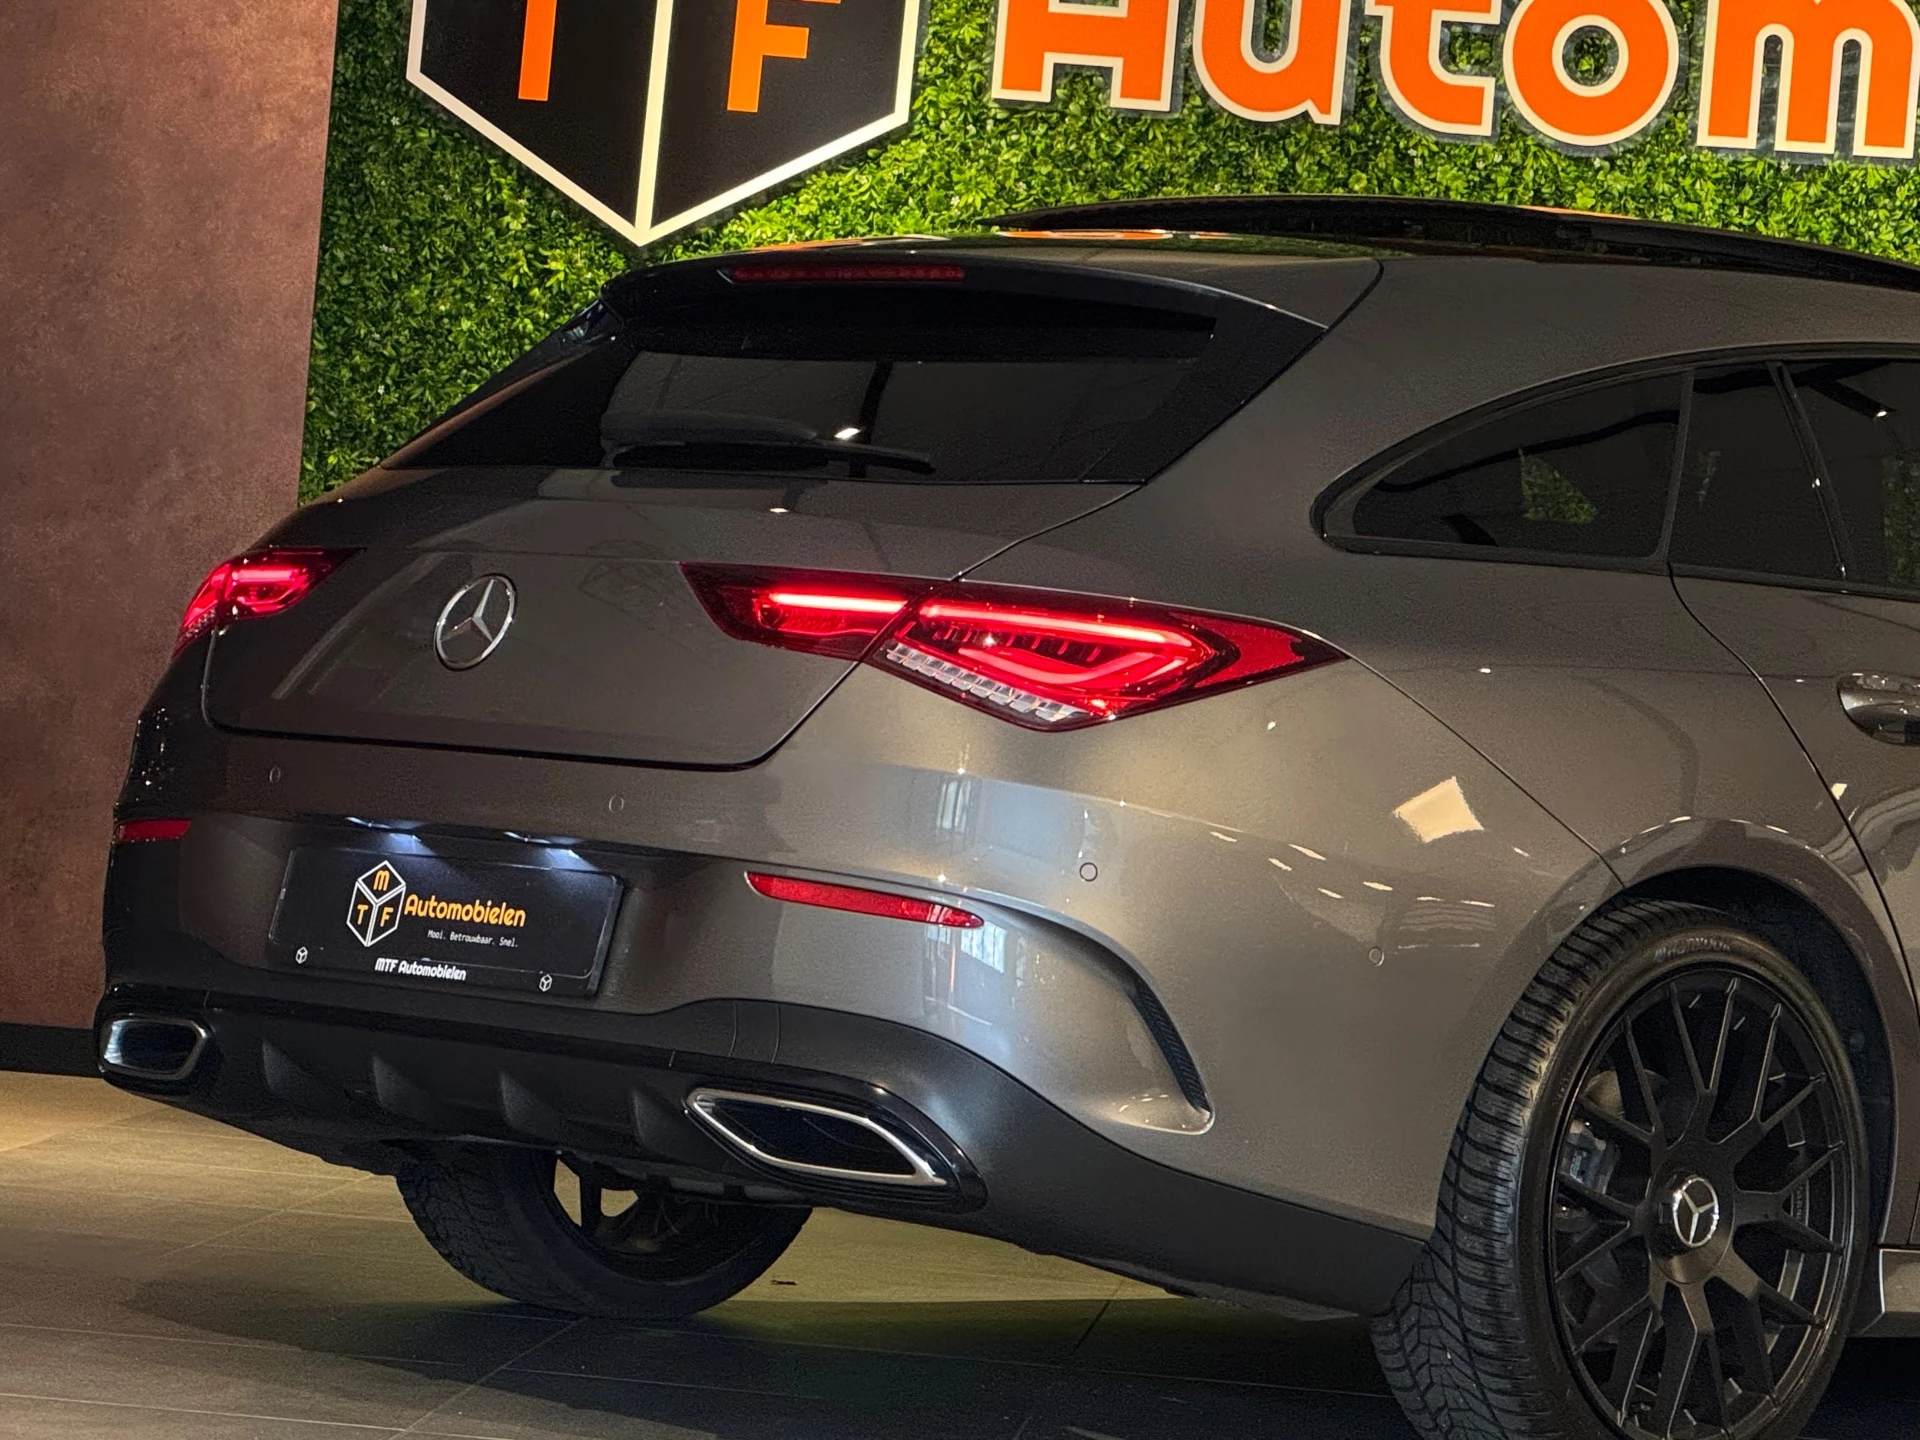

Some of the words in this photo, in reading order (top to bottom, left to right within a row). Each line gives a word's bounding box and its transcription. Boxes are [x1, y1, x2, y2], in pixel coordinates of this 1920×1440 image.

[404, 894, 526, 927] Automobielen
[450, 931, 495, 946] Betrouwbaar.
[499, 937, 519, 948] Snel.
[374, 957, 399, 973] MTF
[398, 961, 467, 981] Automobielen
